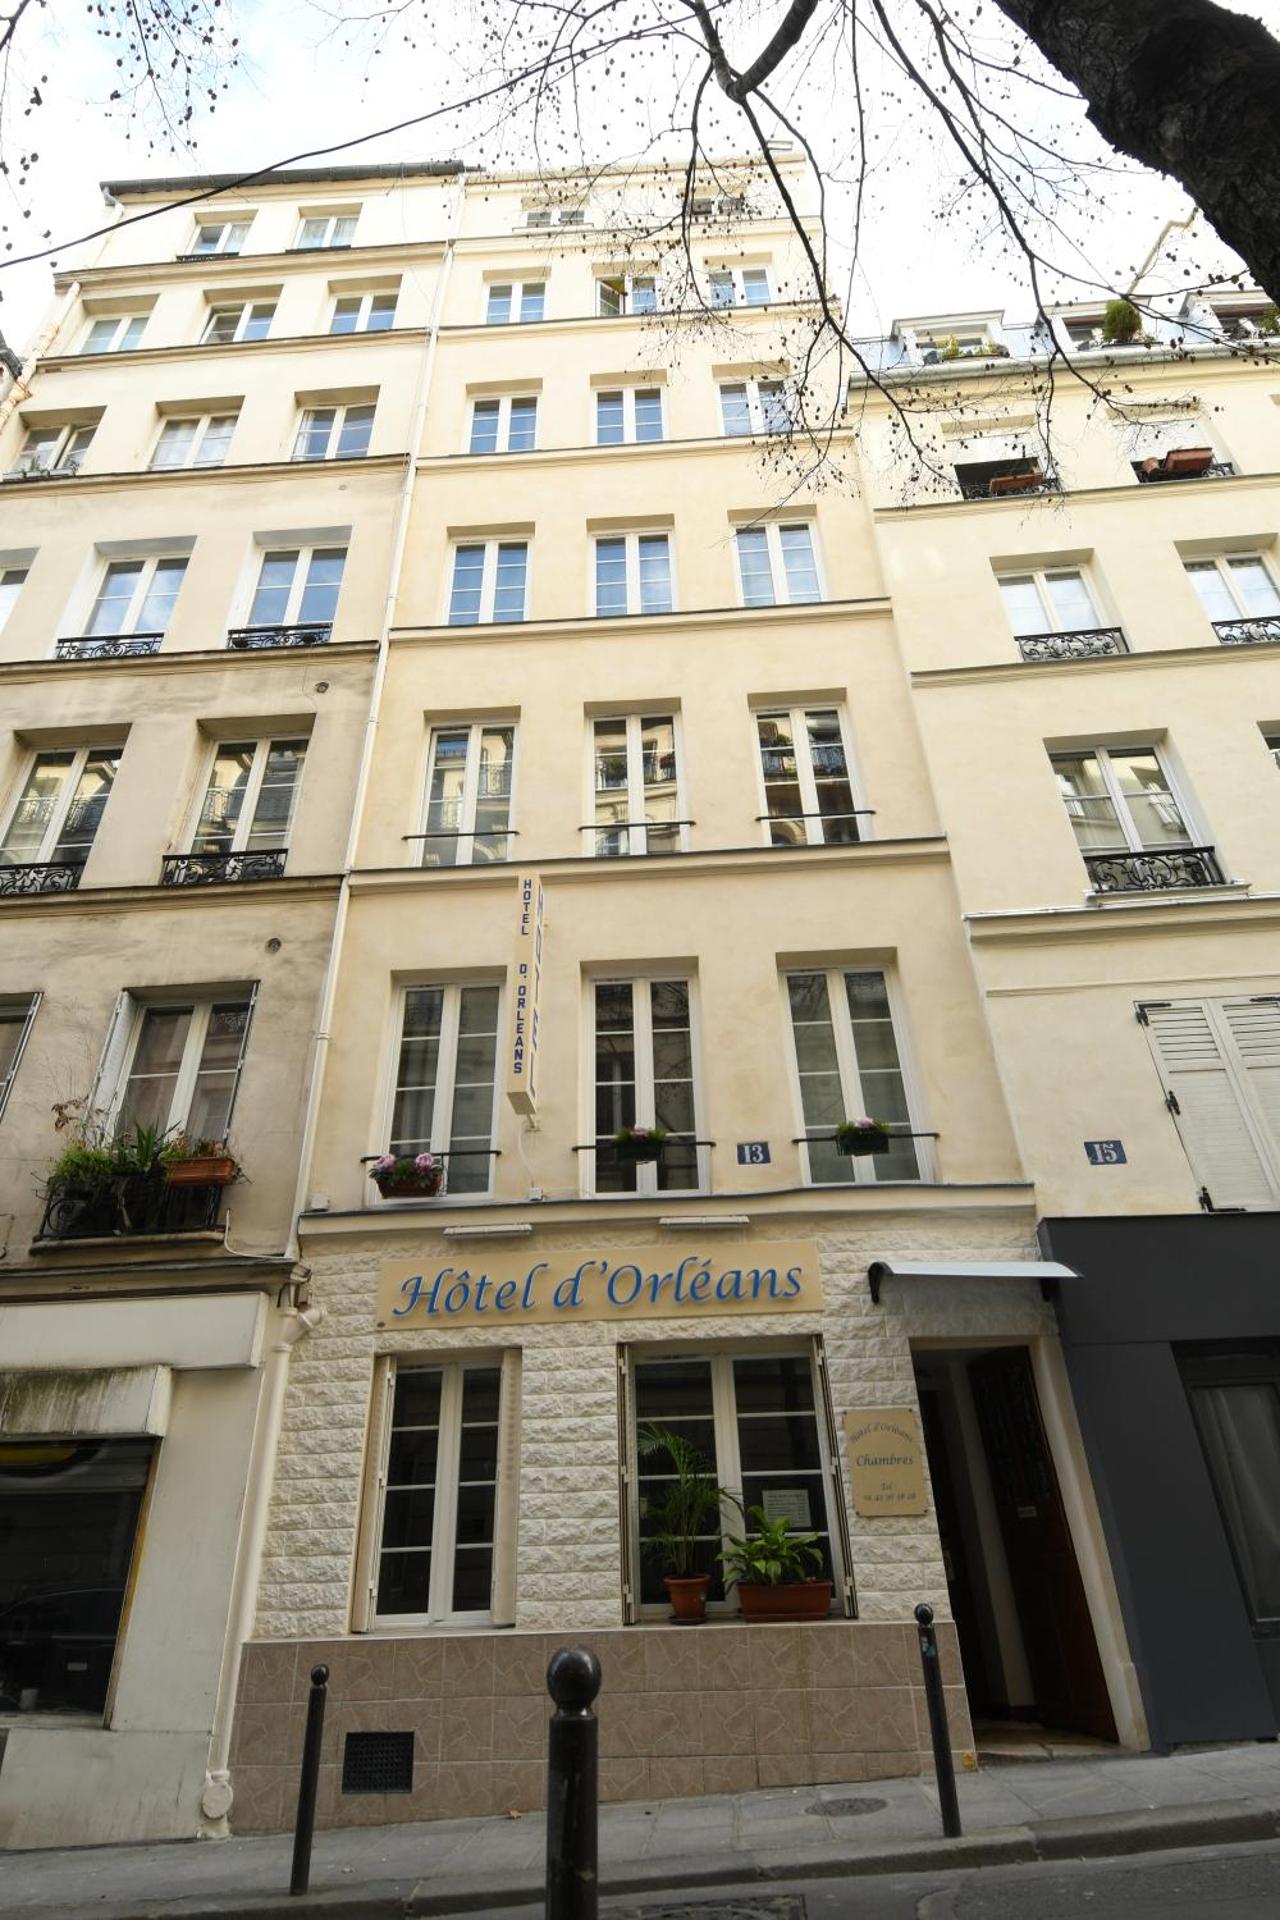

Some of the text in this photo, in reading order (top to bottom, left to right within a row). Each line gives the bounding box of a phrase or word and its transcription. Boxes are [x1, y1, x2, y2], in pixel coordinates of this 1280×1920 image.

[521, 879, 532, 936] HOTEL
[530, 883, 544, 1100] HOTEL
[744, 1144, 764, 1163] 13
[1093, 1143, 1118, 1163] 15
[392, 1256, 802, 1316] Hôtel d'Orléans
[856, 1454, 913, 1467] Chambres
